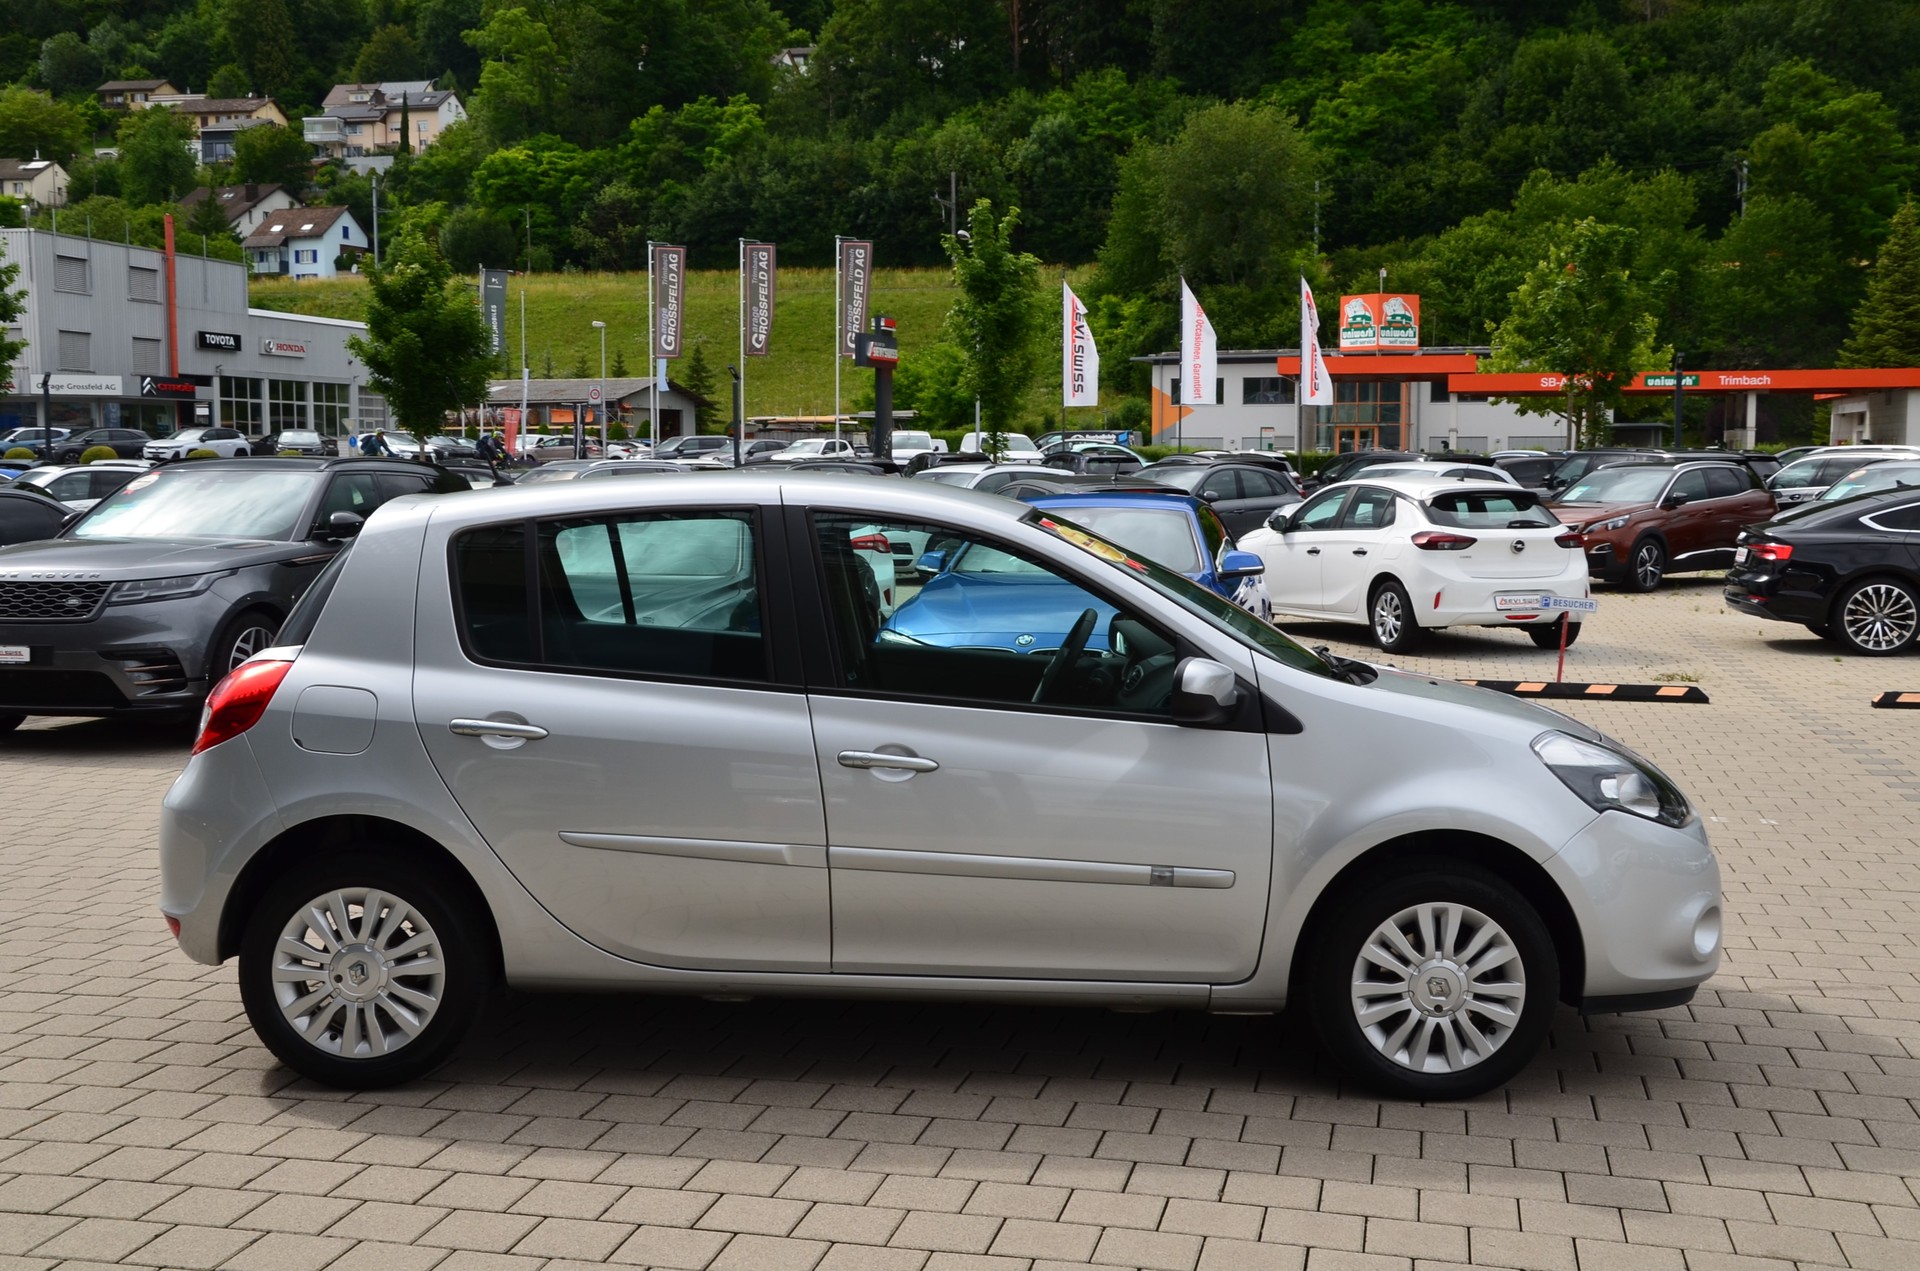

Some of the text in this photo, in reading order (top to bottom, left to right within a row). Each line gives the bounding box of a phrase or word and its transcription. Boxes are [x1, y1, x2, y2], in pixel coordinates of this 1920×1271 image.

[856, 249, 865, 267] AG
[661, 253, 679, 351] GROSSFELD AG
[752, 251, 769, 349] GROSSFELD AG
[205, 334, 235, 346] TOYOTA
[276, 343, 305, 353] HONDA
[1073, 344, 1084, 393] SWISS
[66, 382, 103, 391] Grossfeld
[104, 383, 117, 391] AG
[1193, 363, 1202, 399] Garantiert
[1719, 375, 1771, 386] Trimbach
[1553, 599, 1594, 610] BESUCHER
